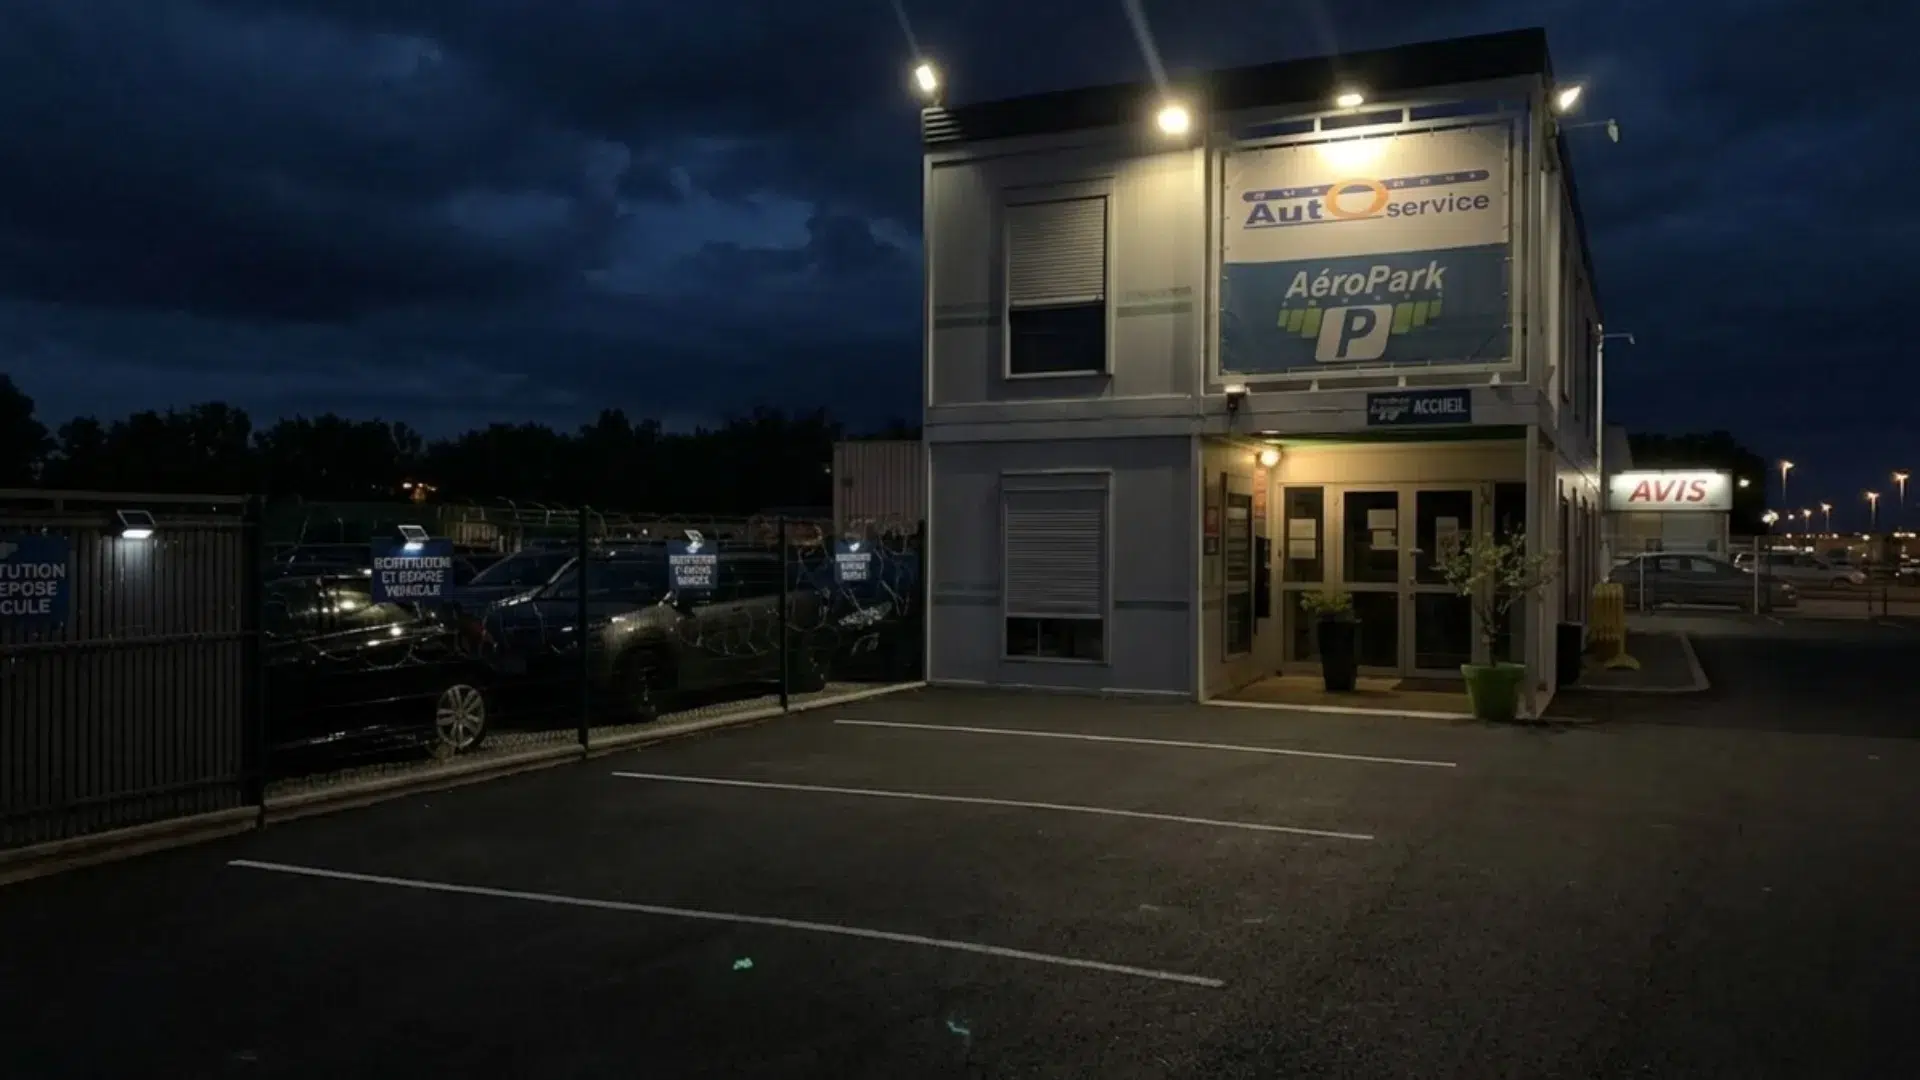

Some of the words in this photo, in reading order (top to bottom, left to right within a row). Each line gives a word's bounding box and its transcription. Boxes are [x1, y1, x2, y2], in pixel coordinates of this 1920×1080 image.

[1285, 260, 1447, 298] AéroPark
[1336, 308, 1377, 358] P
[1628, 479, 1708, 502] AVIS
